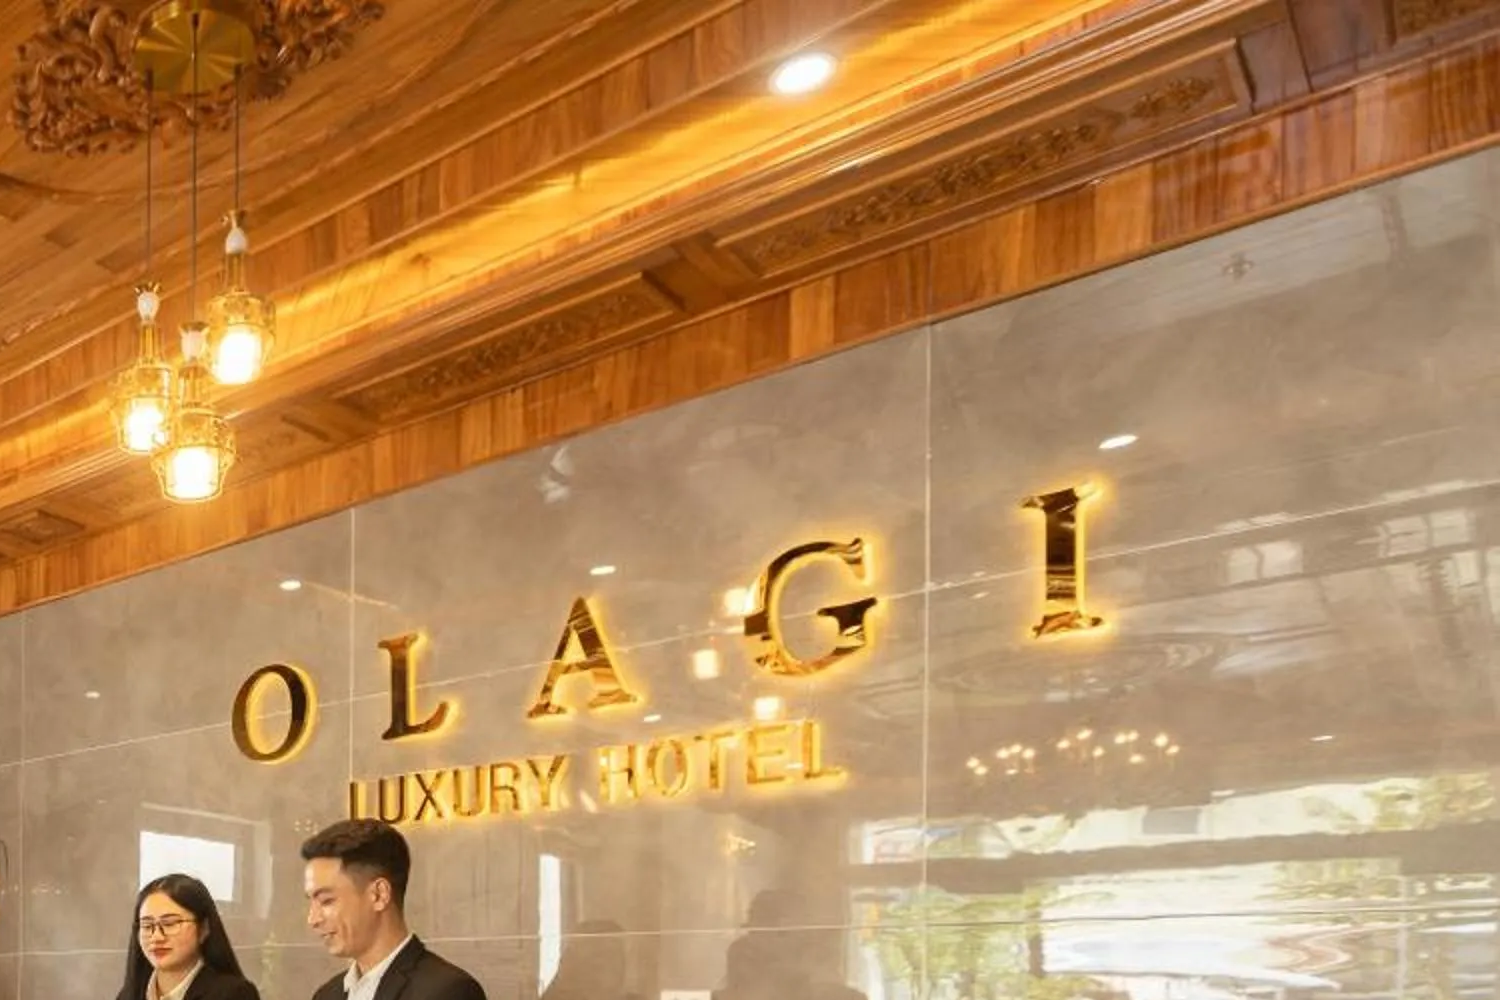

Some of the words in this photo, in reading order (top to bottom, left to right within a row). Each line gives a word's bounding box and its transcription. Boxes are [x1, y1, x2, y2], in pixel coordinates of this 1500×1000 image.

[231, 485, 1105, 762] OLAGI
[349, 755, 568, 825] LUXURY
[599, 720, 845, 800] HOTEL
